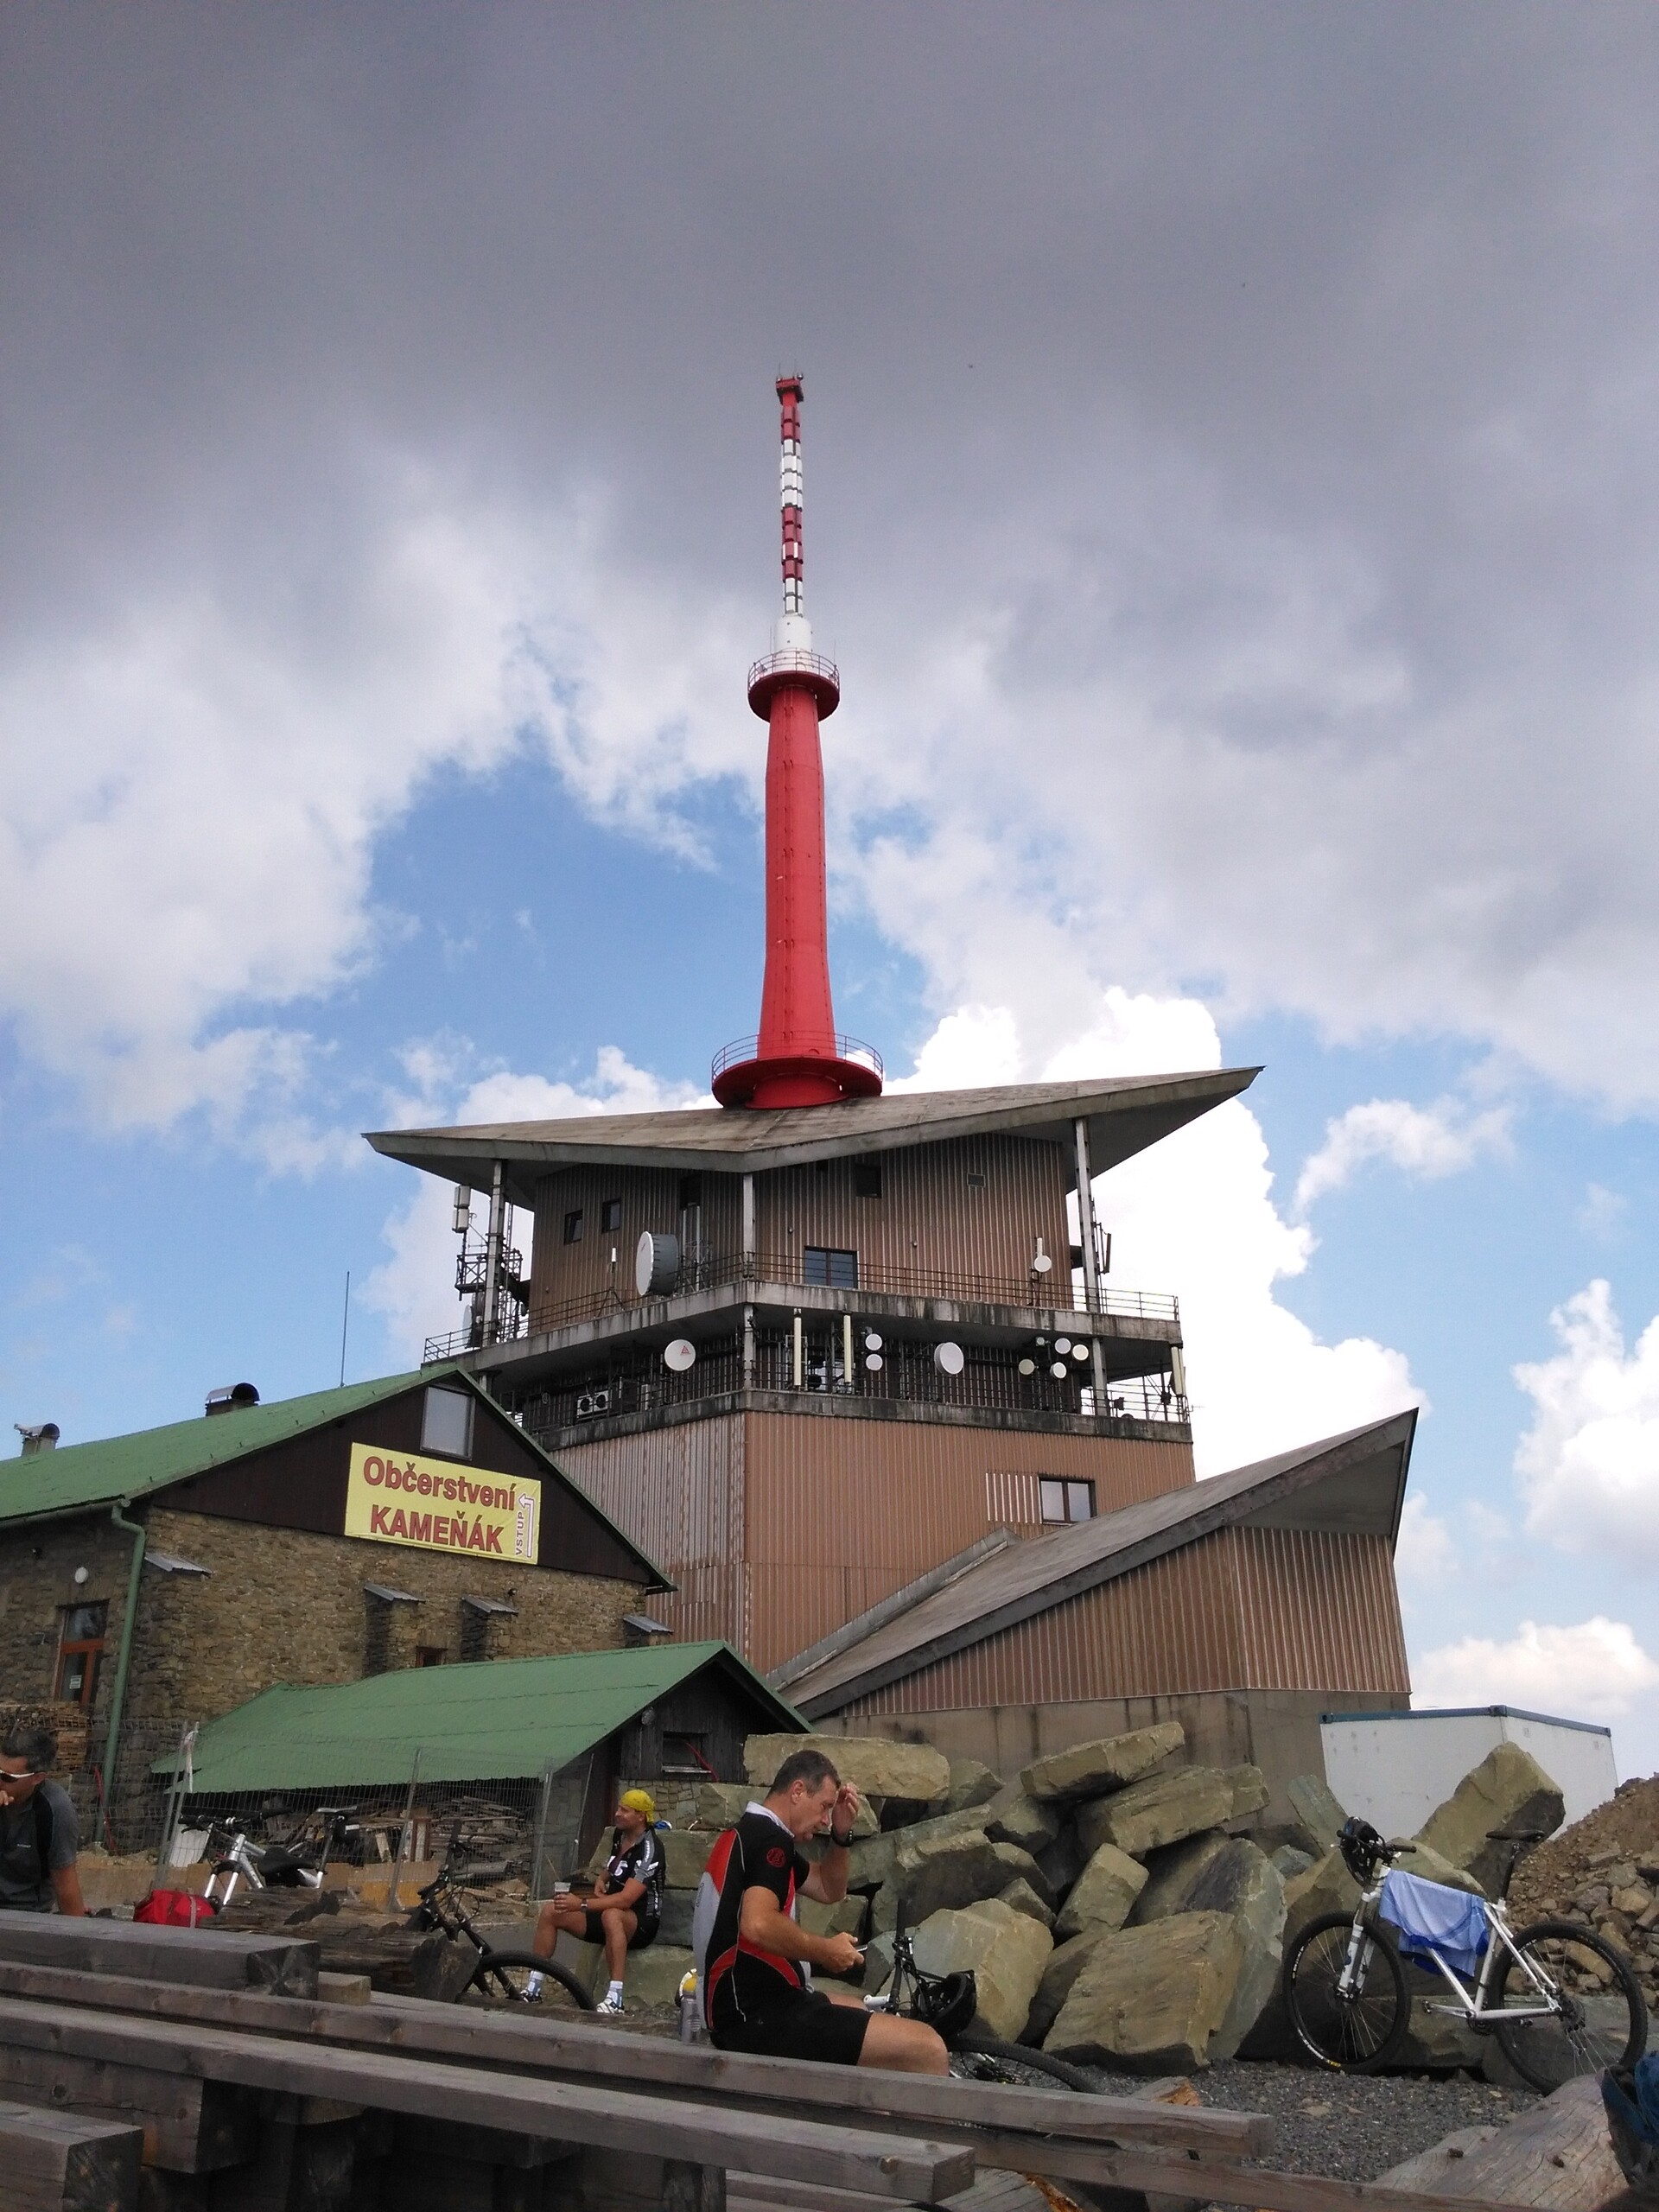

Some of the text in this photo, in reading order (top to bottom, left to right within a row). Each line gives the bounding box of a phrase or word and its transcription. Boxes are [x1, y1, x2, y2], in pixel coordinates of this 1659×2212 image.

[363, 1456, 517, 1510] Občerstvení
[370, 1504, 505, 1554] KAMEŇÁK
[515, 1511, 524, 1556] VSTUP
